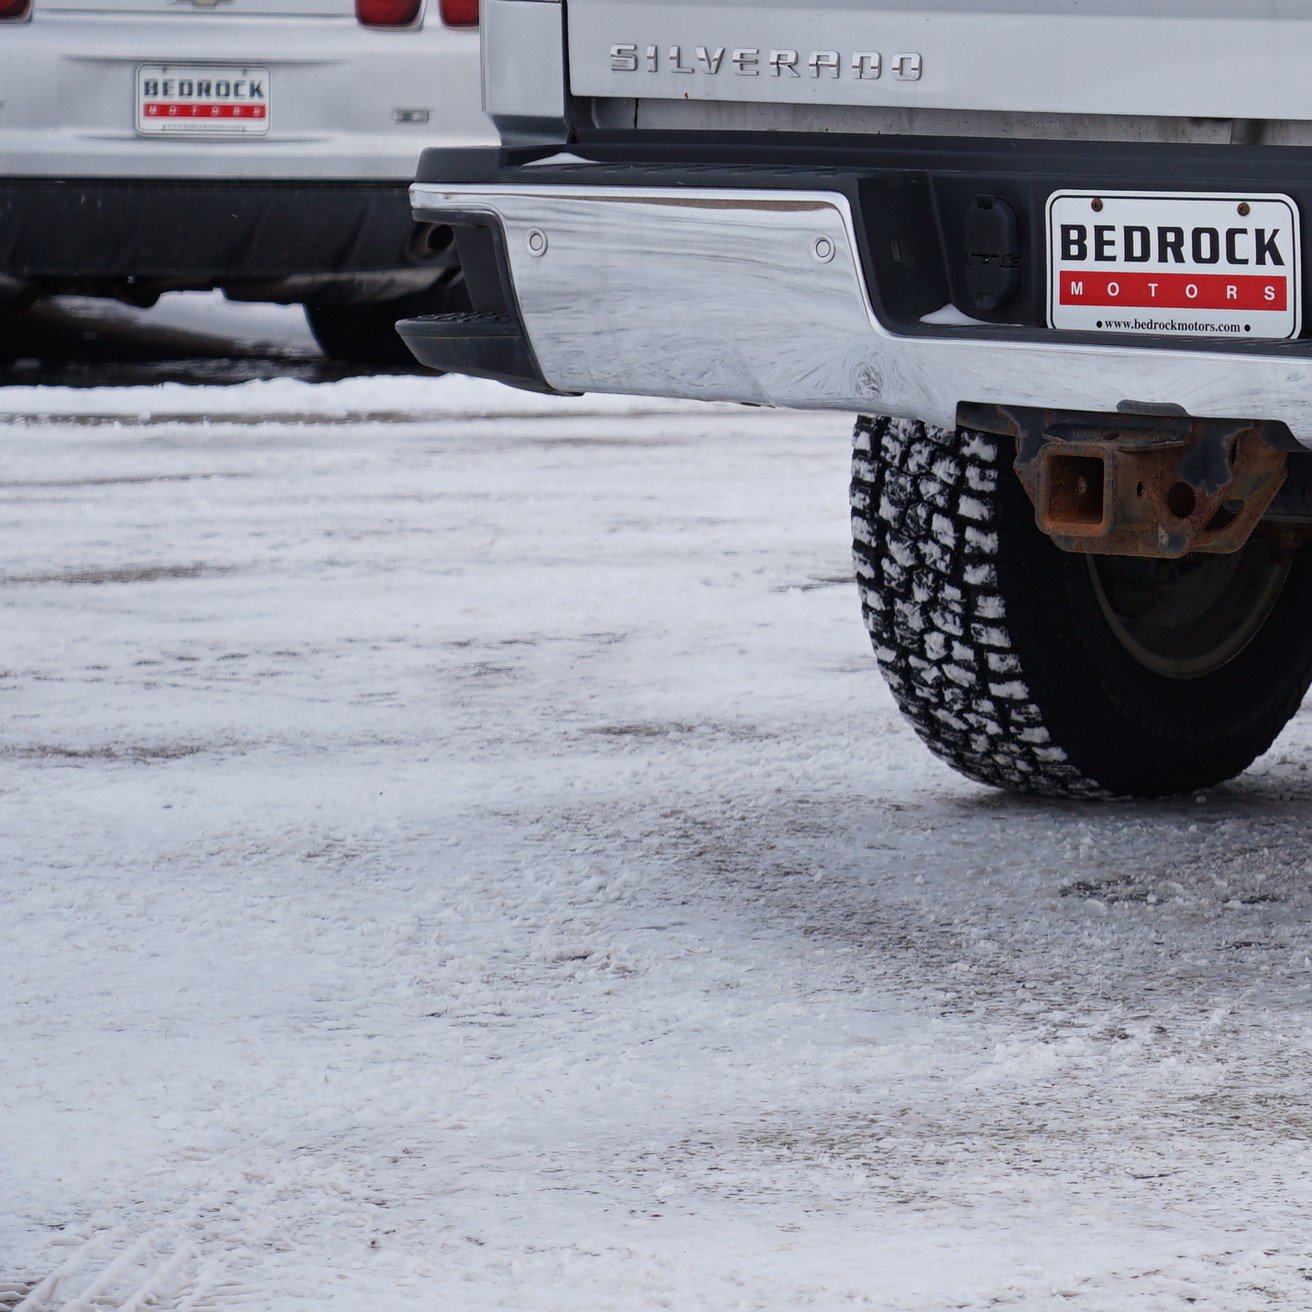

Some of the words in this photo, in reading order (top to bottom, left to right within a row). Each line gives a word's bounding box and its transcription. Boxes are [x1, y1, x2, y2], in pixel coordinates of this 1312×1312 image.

[610, 44, 923, 81] SILVERADO
[143, 78, 265, 99] BEDROCK
[1060, 224, 1285, 265] BEDROCK
[1071, 281, 1275, 301] MOTORS
[1105, 318, 1240, 333] www.bedrockmotors.com
